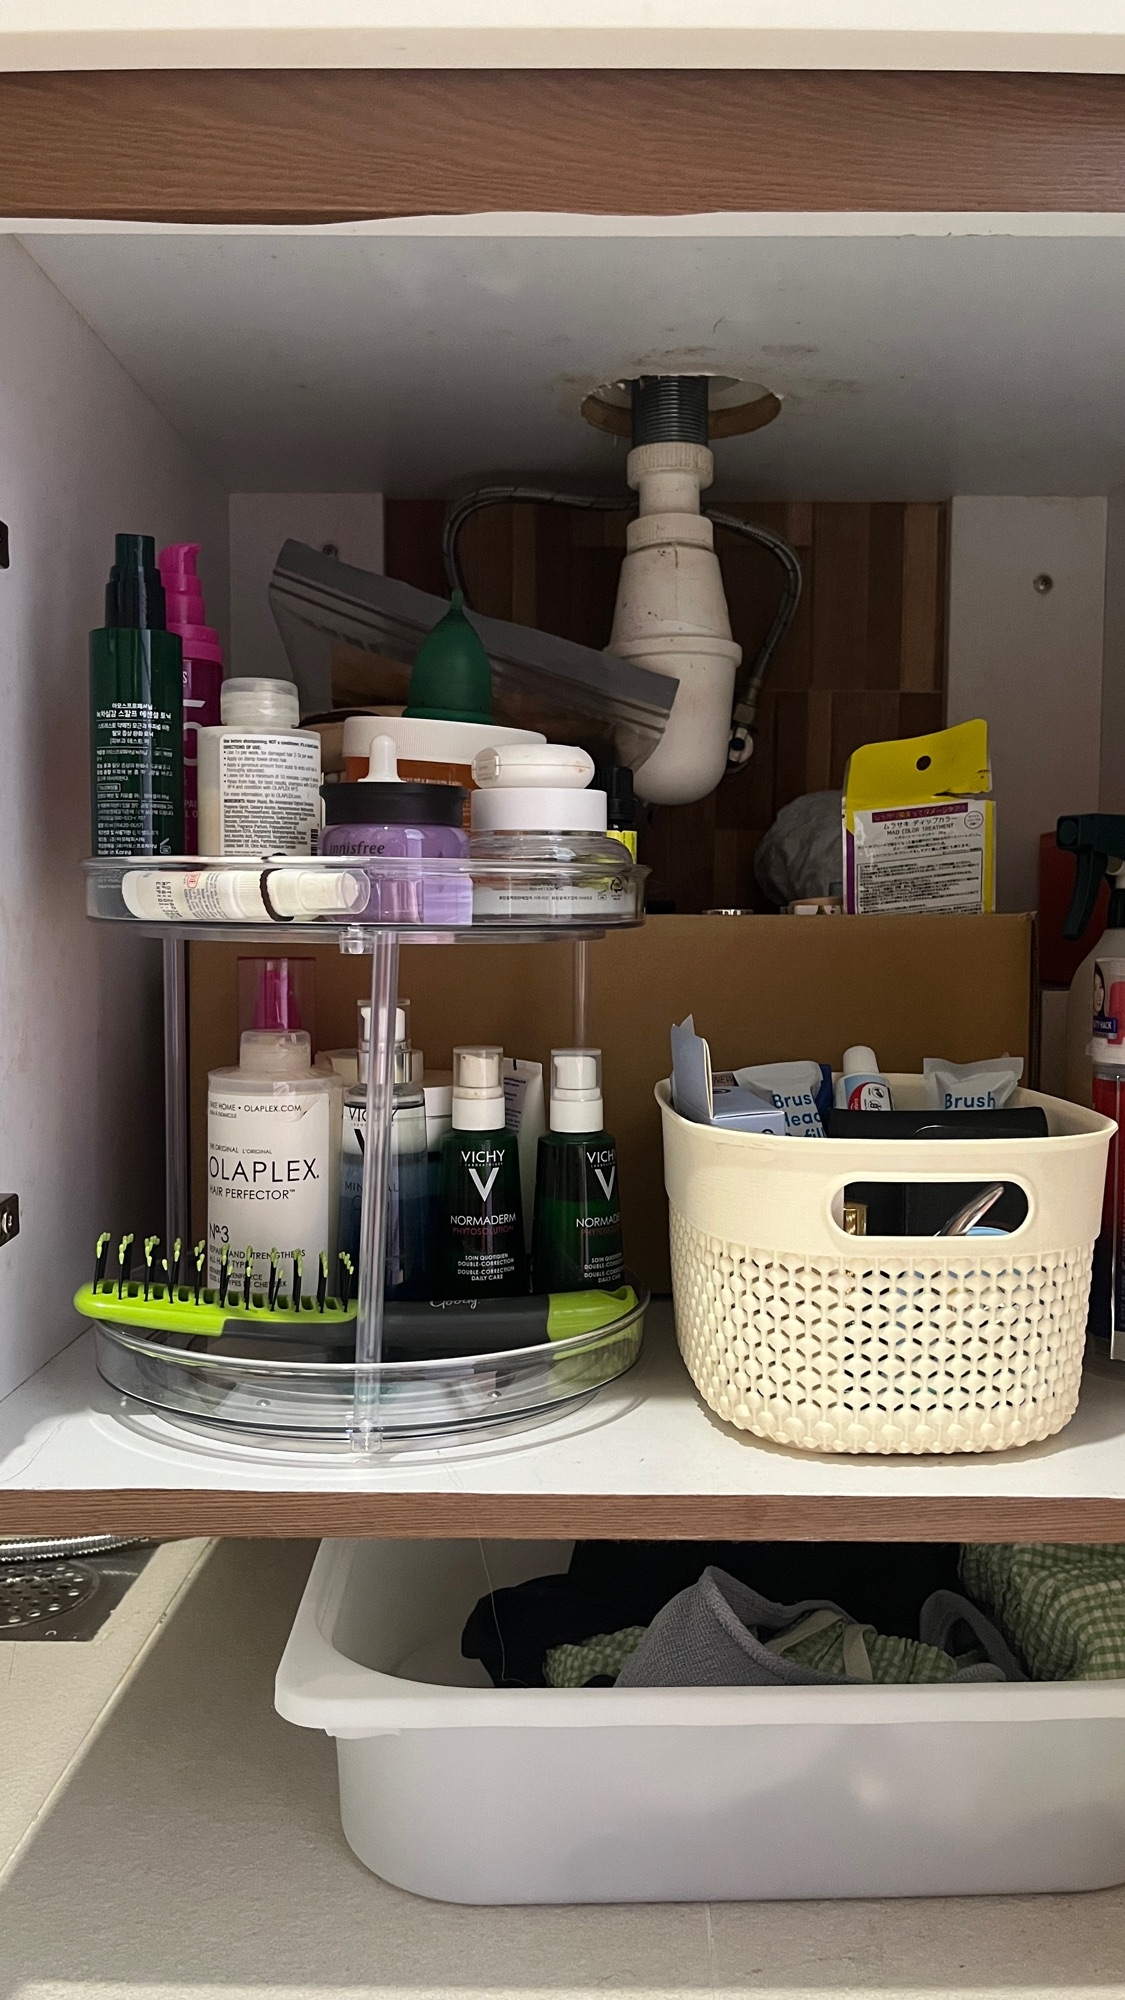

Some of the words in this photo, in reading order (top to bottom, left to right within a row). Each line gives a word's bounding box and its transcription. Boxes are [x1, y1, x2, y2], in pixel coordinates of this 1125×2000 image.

[922, 823, 954, 832] TREATMENT
[330, 841, 385, 855] innisfree
[713, 1075, 733, 1084] NEW
[219, 1103, 236, 1111] HOME
[772, 1094, 812, 1109] Brus
[945, 1091, 995, 1110] Brush
[349, 1107, 399, 1122] VICY
[461, 1149, 505, 1163] VICHY
[586, 1149, 616, 1164] VICH
[450, 1212, 516, 1226] NORMADERM
[576, 1212, 620, 1228] NORMADE
[453, 1225, 513, 1236] PHYTOSOLUTION
[229, 1250, 245, 1259] AND
[457, 1258, 514, 1267] DOUBLE-CORRECTION
[457, 1266, 515, 1275] DOUBLE-CORRECTION
